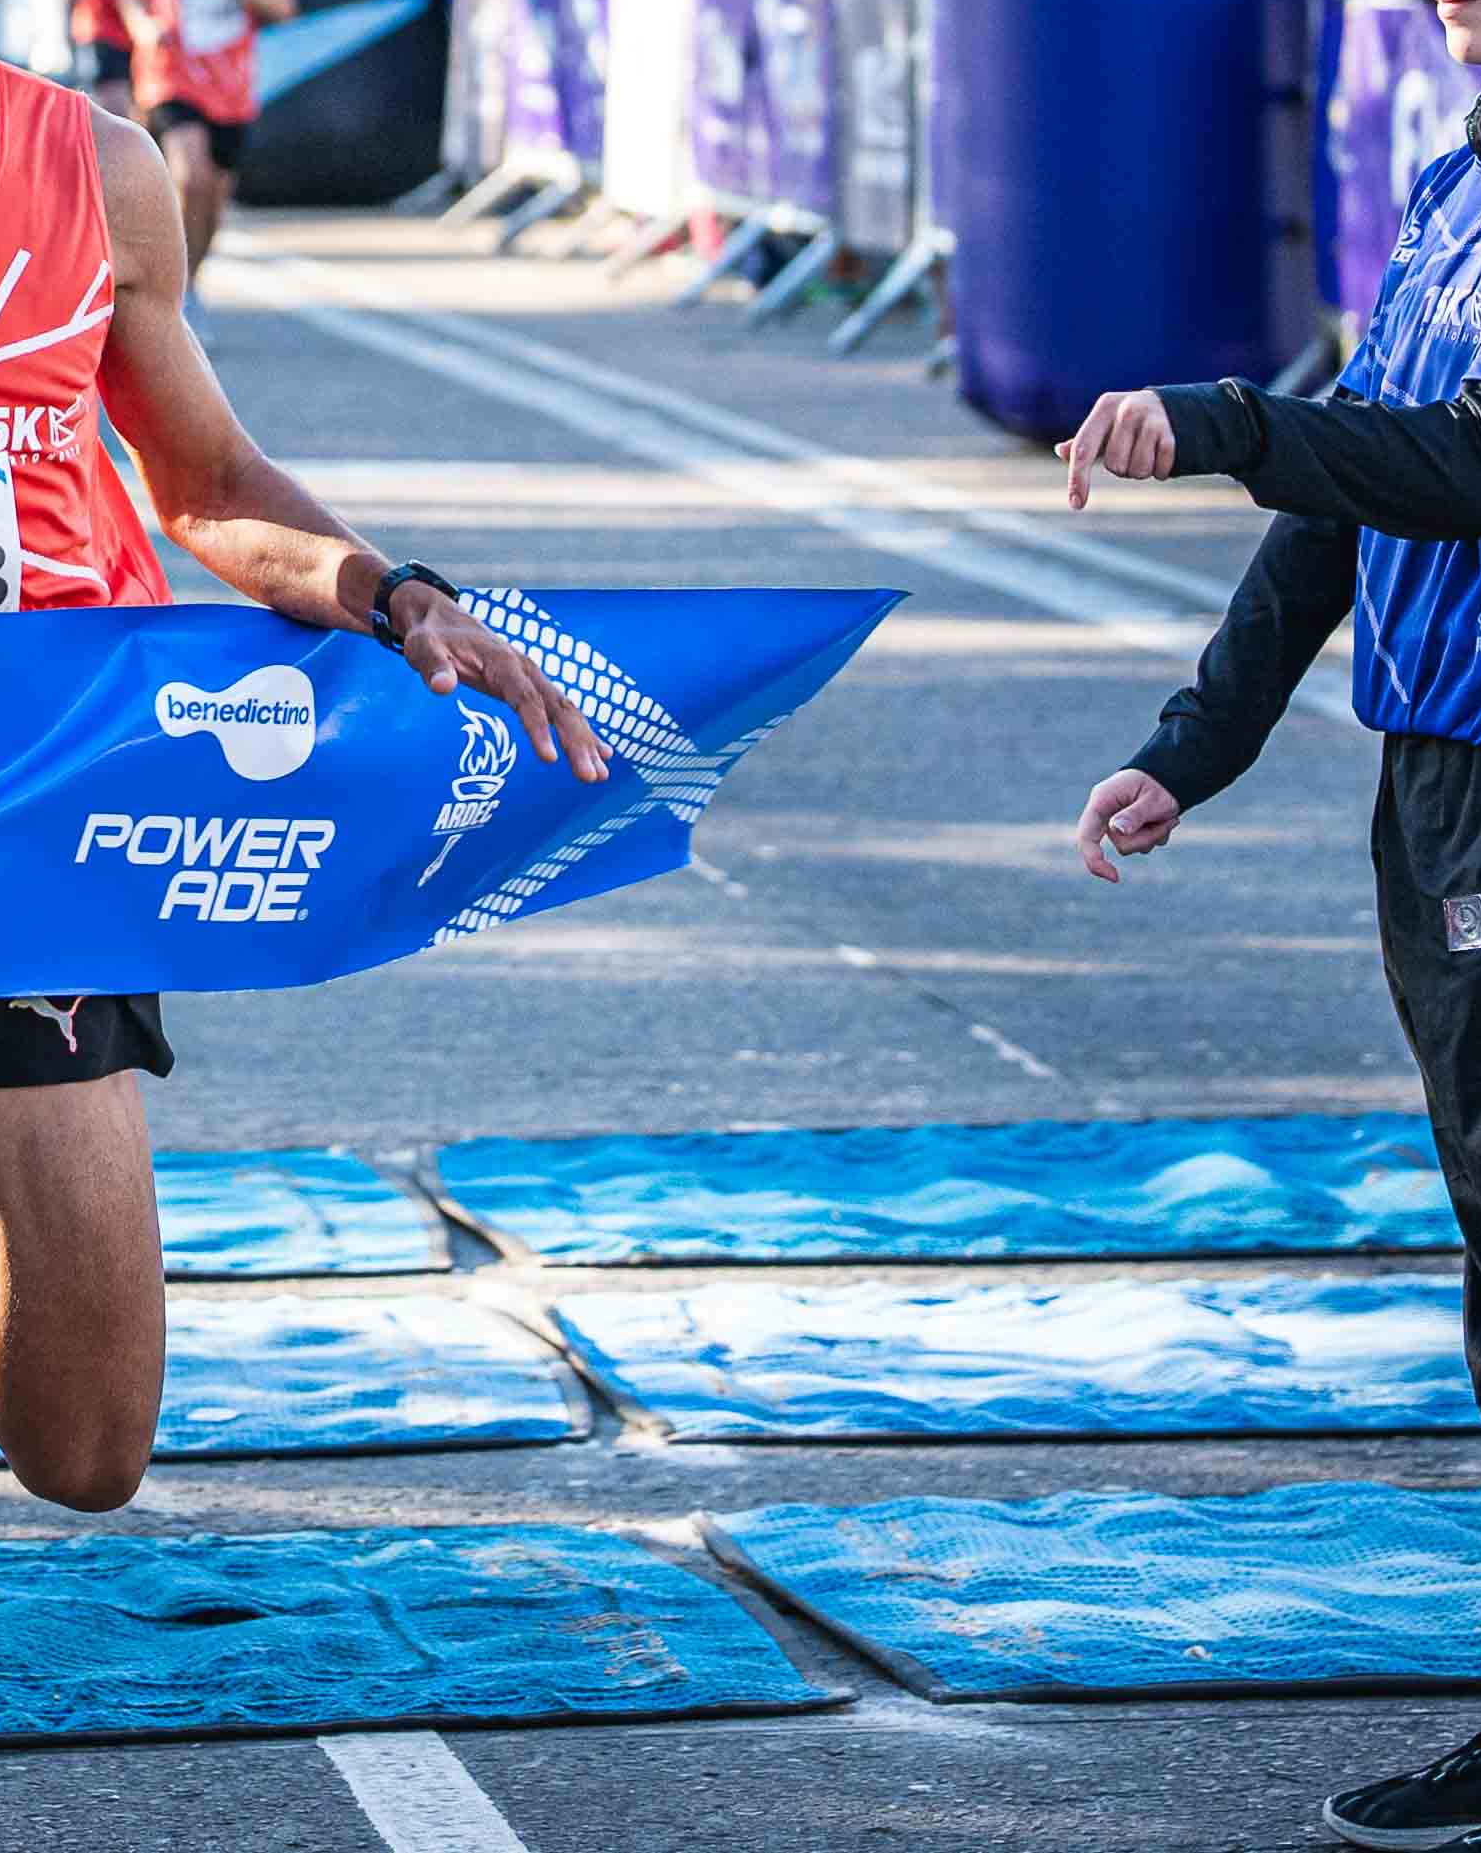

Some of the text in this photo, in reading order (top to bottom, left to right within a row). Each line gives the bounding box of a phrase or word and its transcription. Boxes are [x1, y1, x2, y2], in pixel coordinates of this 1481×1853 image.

[166, 690, 312, 728] benedictino
[434, 800, 500, 831] ARDEC
[75, 813, 336, 869] POWER
[158, 869, 311, 922] ADE
